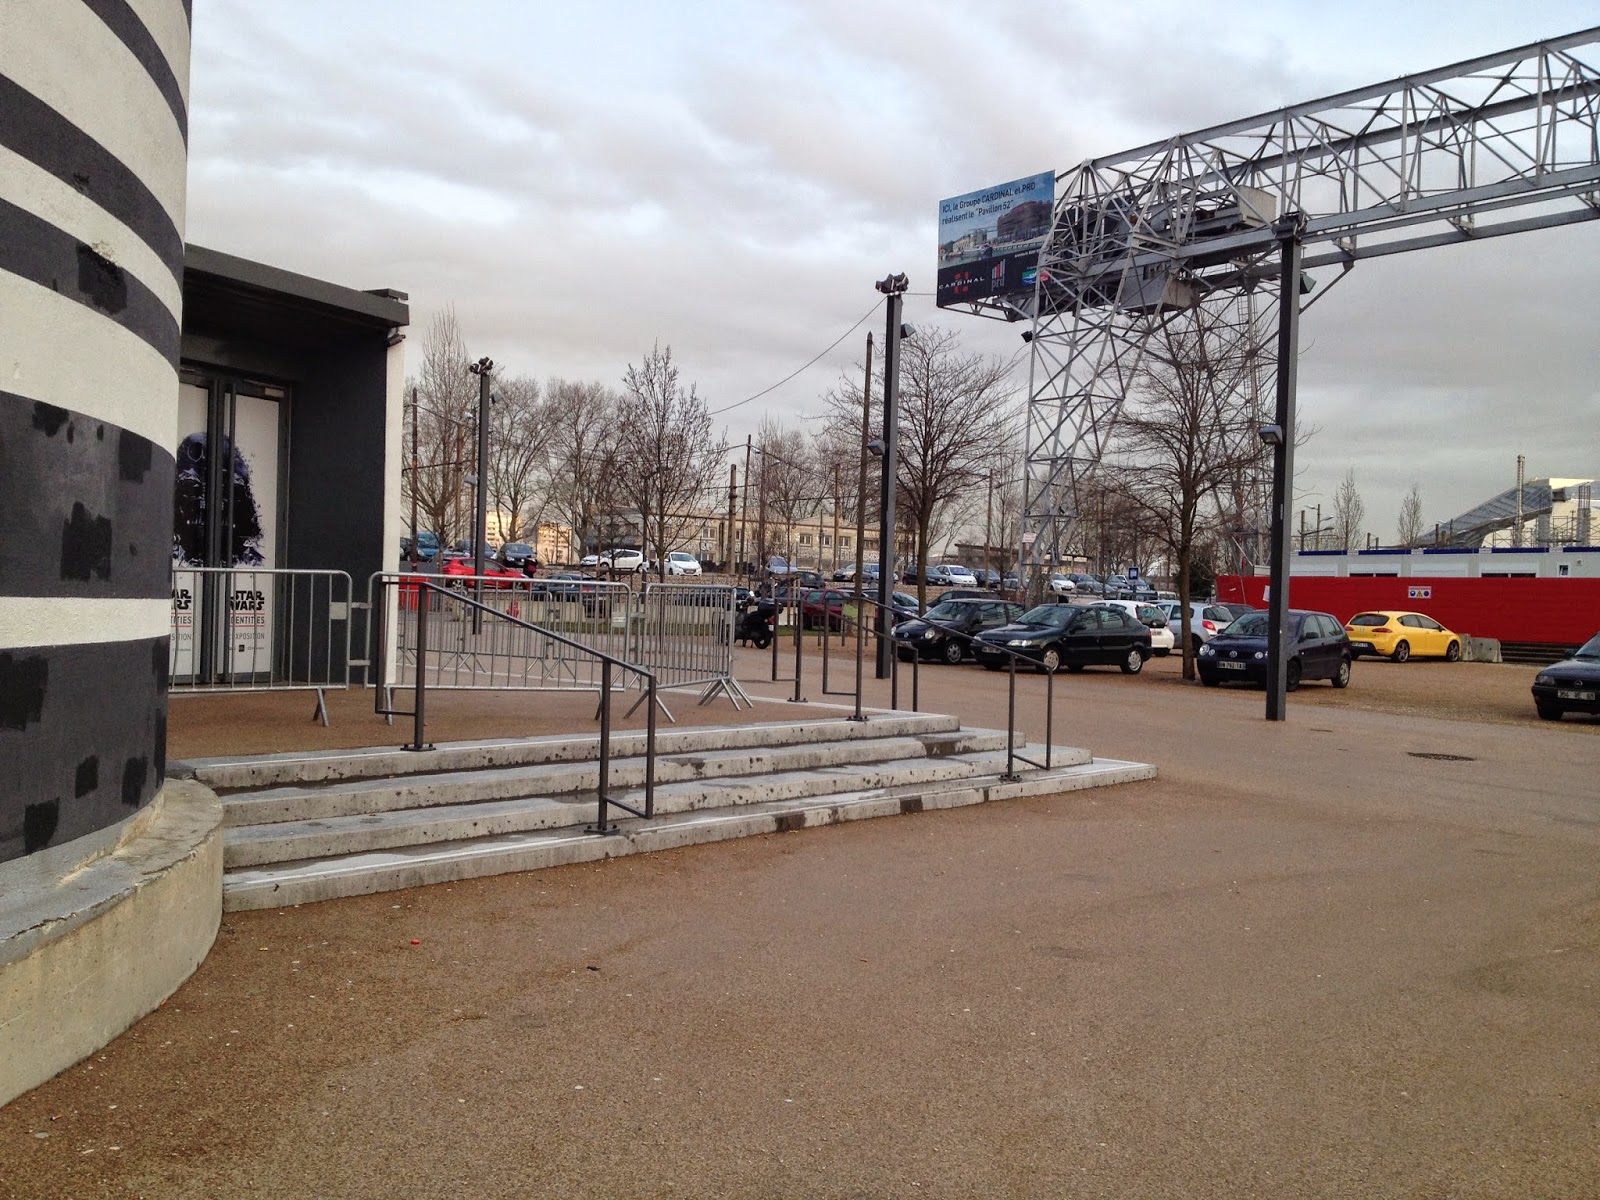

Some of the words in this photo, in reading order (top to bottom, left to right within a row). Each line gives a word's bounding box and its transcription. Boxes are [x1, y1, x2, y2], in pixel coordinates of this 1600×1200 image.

[960, 198, 980, 209] Groupe
[982, 190, 1013, 203] CARDINAL
[969, 210, 974, 218] le
[939, 277, 985, 289] CARDINAL
